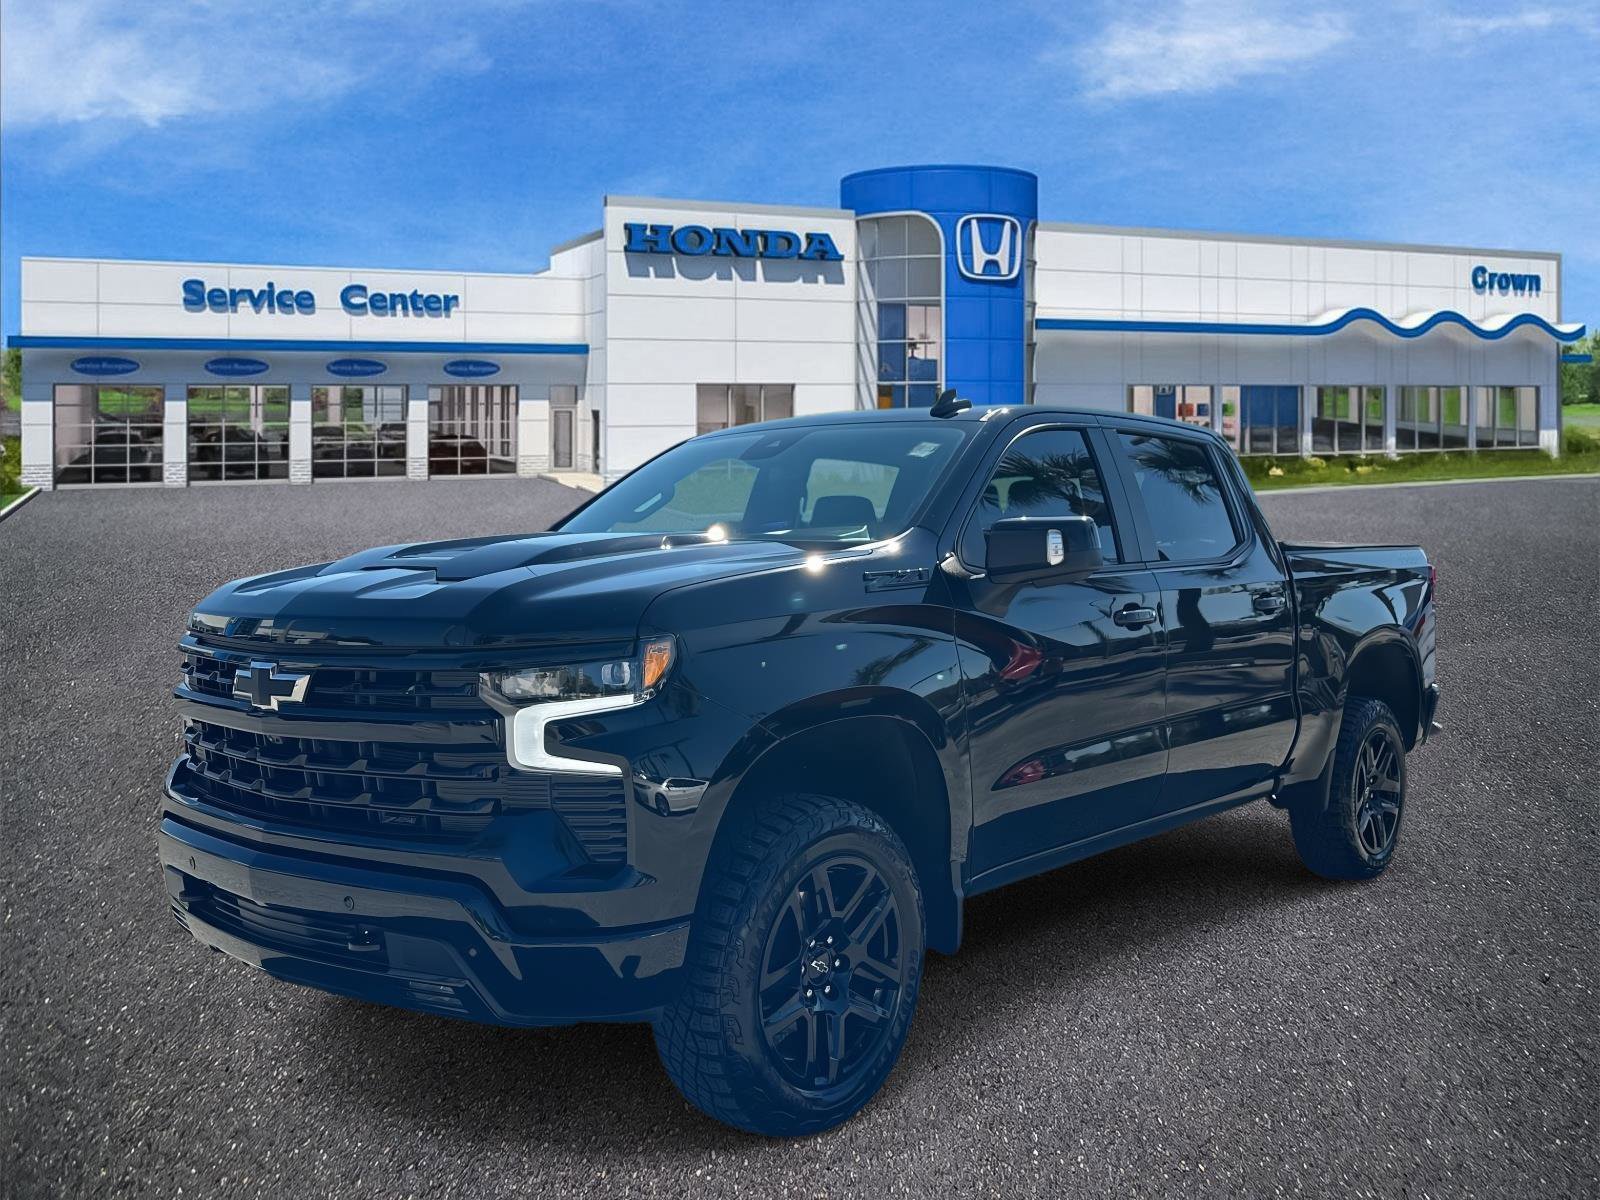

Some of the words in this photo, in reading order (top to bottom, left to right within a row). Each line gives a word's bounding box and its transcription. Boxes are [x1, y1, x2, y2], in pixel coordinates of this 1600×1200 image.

[624, 222, 844, 261] HONDA
[1471, 265, 1541, 292] Crown
[182, 279, 316, 313] Service
[340, 284, 459, 315] Center
